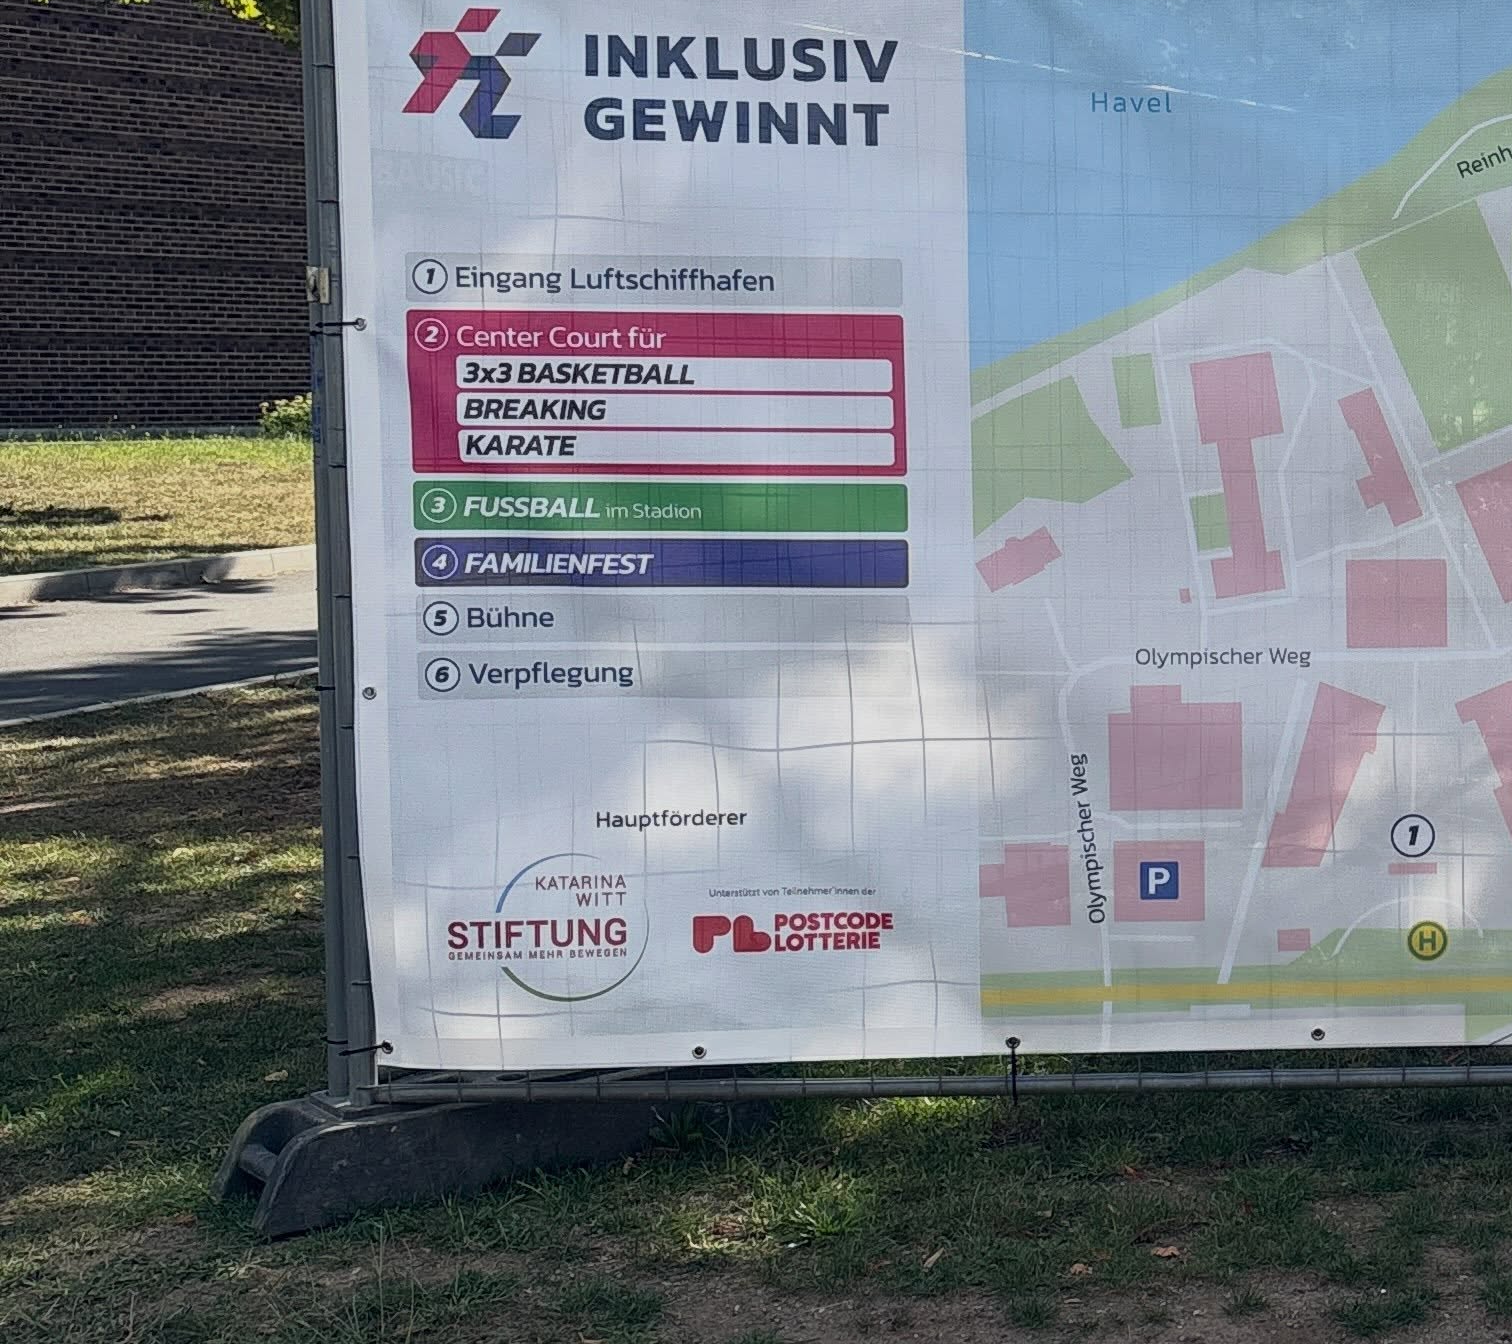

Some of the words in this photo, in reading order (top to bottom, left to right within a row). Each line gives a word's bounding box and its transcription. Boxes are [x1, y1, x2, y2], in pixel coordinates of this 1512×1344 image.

[584, 33, 899, 83] INKLUSIV
[1091, 92, 1173, 113] Havel
[583, 97, 890, 146] GEWINNT
[421, 267, 437, 286] 1
[455, 266, 562, 294] Eingang
[570, 267, 776, 292] Luftschiffhafen
[424, 327, 440, 344] 2
[456, 326, 543, 348] Center
[549, 327, 623, 349] Court
[628, 327, 667, 350] für
[463, 363, 512, 385] 3x3
[517, 362, 695, 386] BASKETBALL
[464, 400, 607, 421] BREAKING
[465, 436, 577, 457] KARATE
[431, 498, 447, 515] 3
[464, 496, 600, 519] FUSSBALL
[605, 504, 627, 518] im
[633, 503, 702, 520] Stadion
[432, 553, 449, 571] 4
[464, 553, 654, 575] FAMILIENFEST
[435, 610, 447, 626] 5
[466, 608, 555, 629] Bühne
[1135, 648, 1264, 668] Olympischer
[1269, 648, 1311, 668] Weg
[434, 666, 450, 683] 6
[468, 664, 634, 689] Verpflegung
[1070, 753, 1089, 797] Weg
[596, 809, 748, 832] Hauptförderer
[1408, 824, 1419, 846] 1
[1075, 801, 1106, 925] Olympischer
[535, 874, 627, 891] KATARINA
[1148, 867, 1169, 894] P
[576, 891, 627, 907] WITT
[762, 887, 779, 897] von
[861, 887, 876, 896] der
[774, 912, 894, 931] POSTCODE
[447, 917, 628, 950] STIFTUNG
[774, 932, 881, 952] LOTTERIE
[1418, 932, 1436, 951] H
[448, 949, 523, 961] GEMEINSAM
[528, 949, 563, 959] MEHR
[569, 947, 627, 959] BEWEGEN
